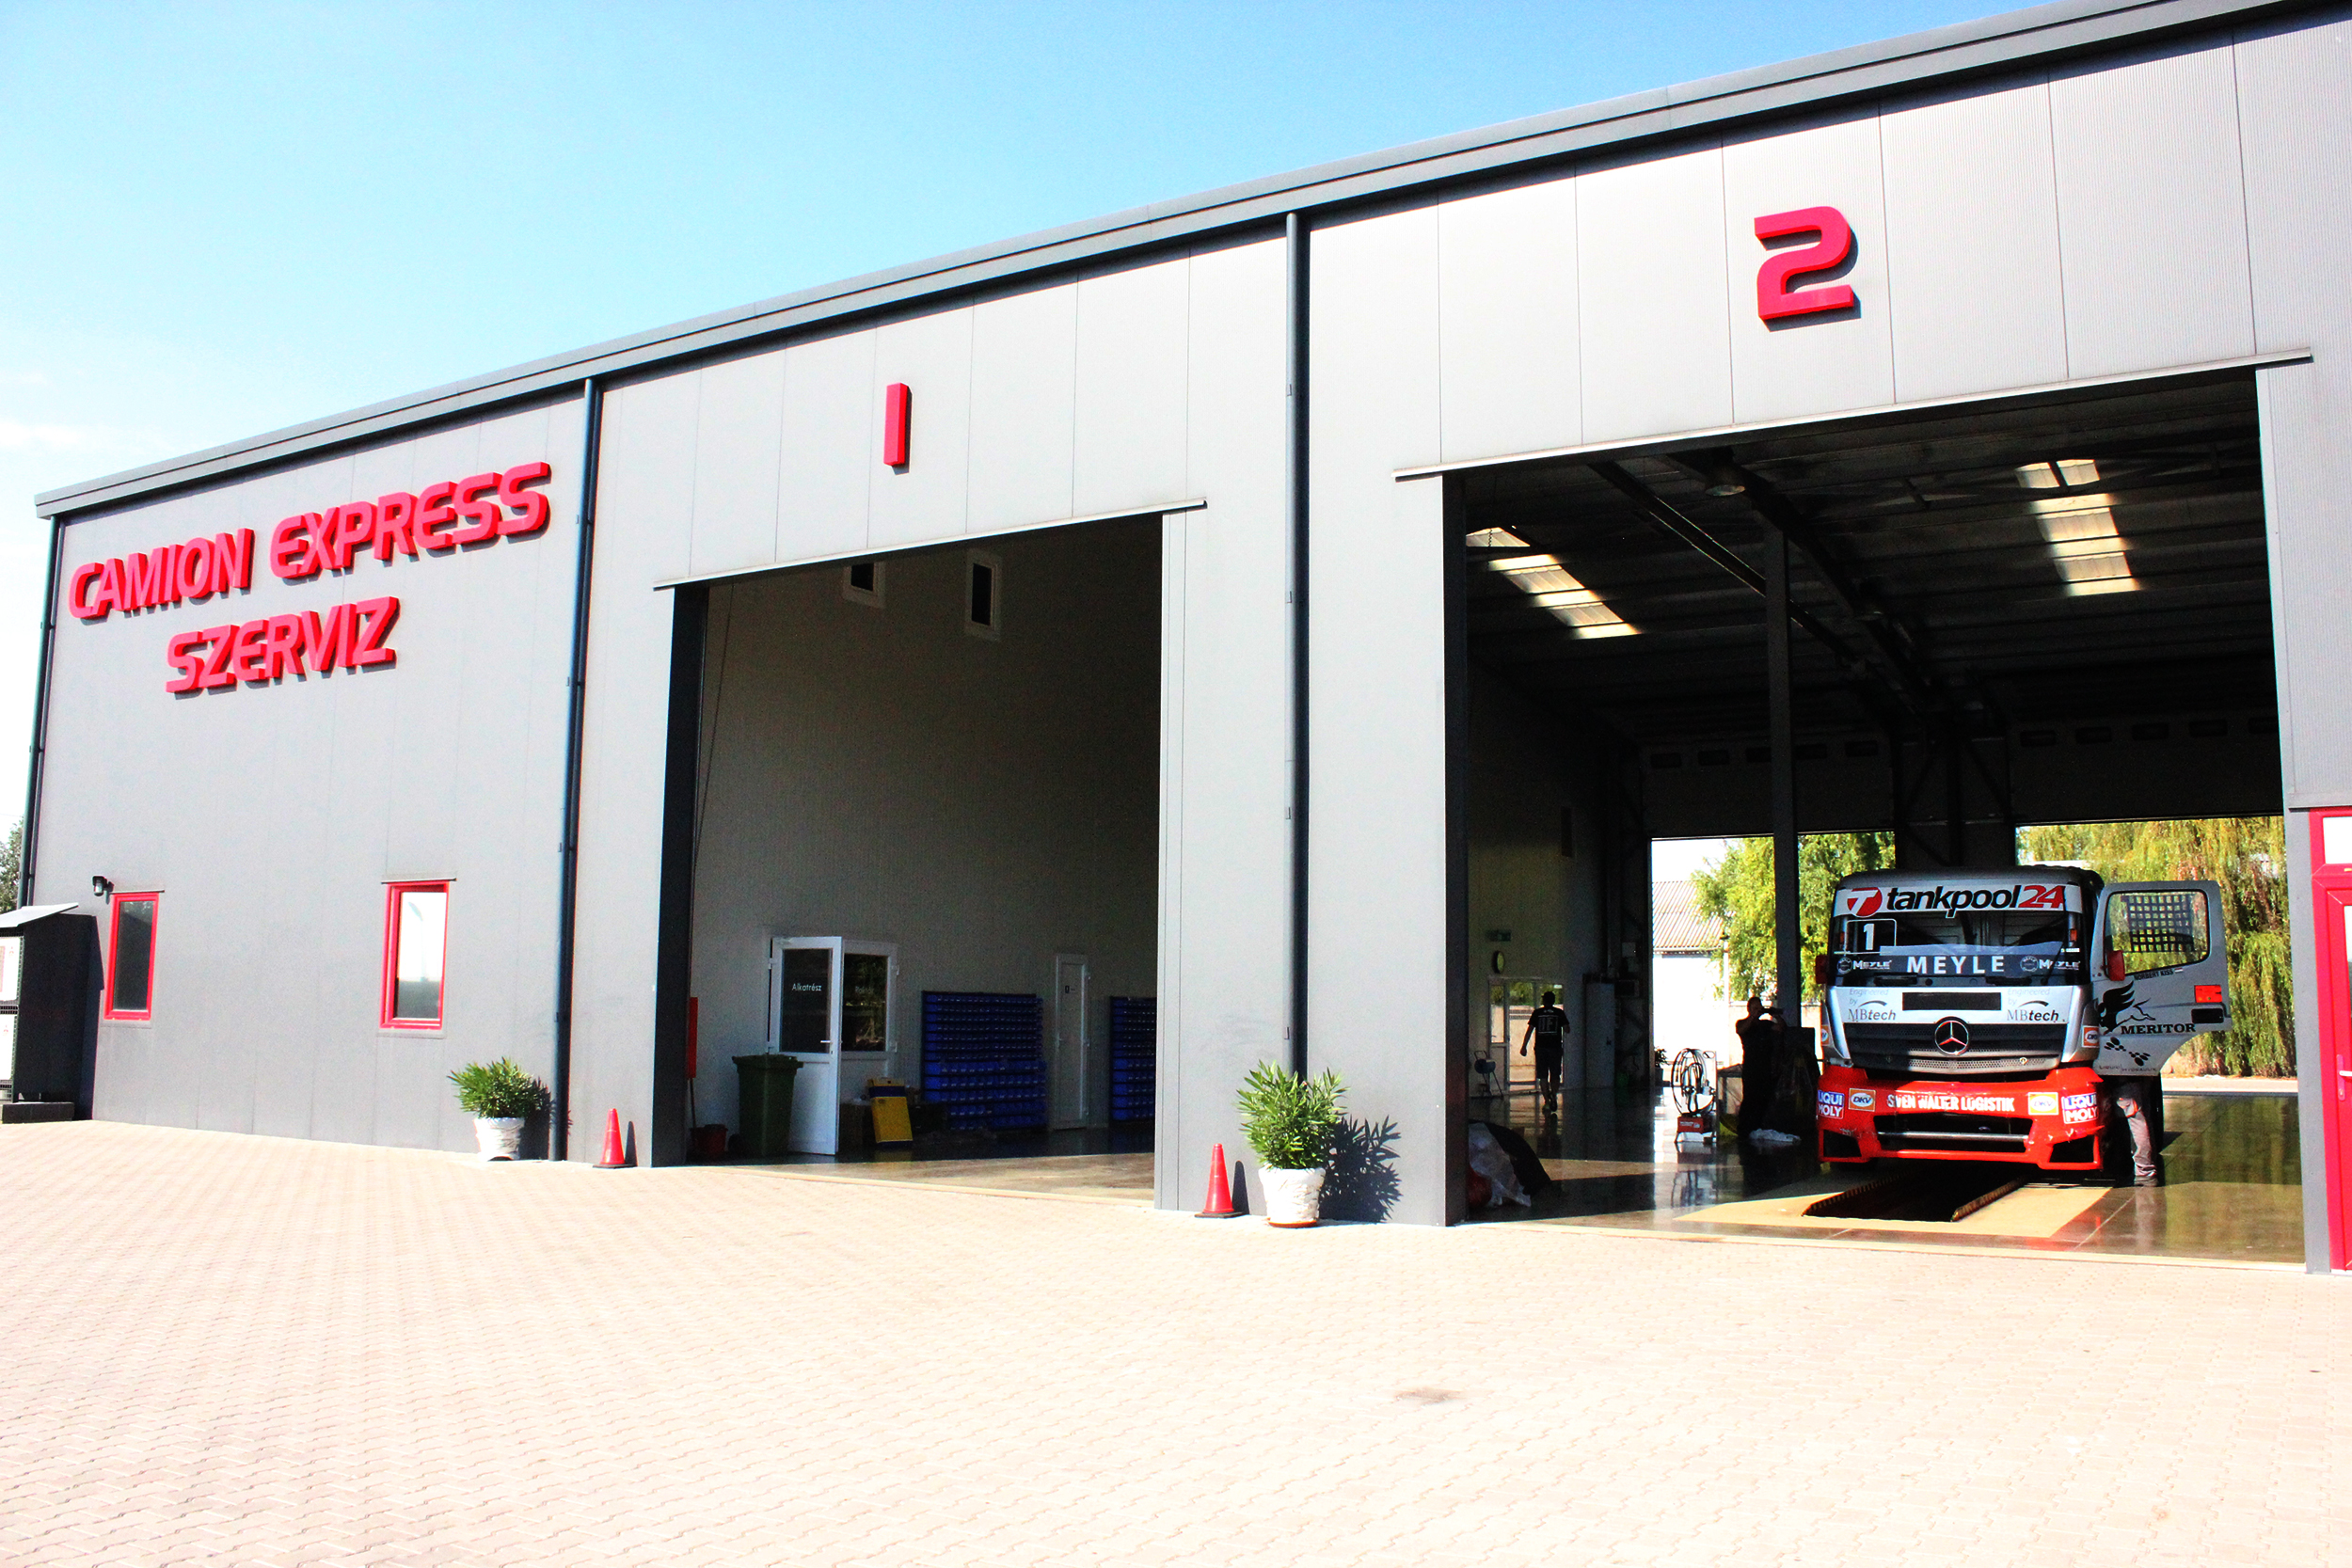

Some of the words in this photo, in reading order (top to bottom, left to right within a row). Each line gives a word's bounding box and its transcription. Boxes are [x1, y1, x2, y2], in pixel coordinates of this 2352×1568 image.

[1755, 206, 1860, 322] 2
[69, 528, 256, 620] CAMION
[270, 461, 552, 579] EXPRESS
[166, 595, 400, 694] SZERVIZ
[1886, 885, 2065, 918] tankpool24
[1863, 923, 1875, 951] 1
[1906, 956, 2005, 974] MEYLE
[2039, 958, 2080, 971] MYLE
[1848, 1008, 1897, 1022] MBtech
[2007, 1009, 2059, 1022] MBtech
[2121, 1023, 2196, 1035] MERITOR
[1852, 1096, 1872, 1104] DKV
[1887, 1094, 1916, 1109] SVEN
[1961, 1096, 2015, 1113] LOGISTIK
[2065, 1107, 2098, 1123] MOLY
